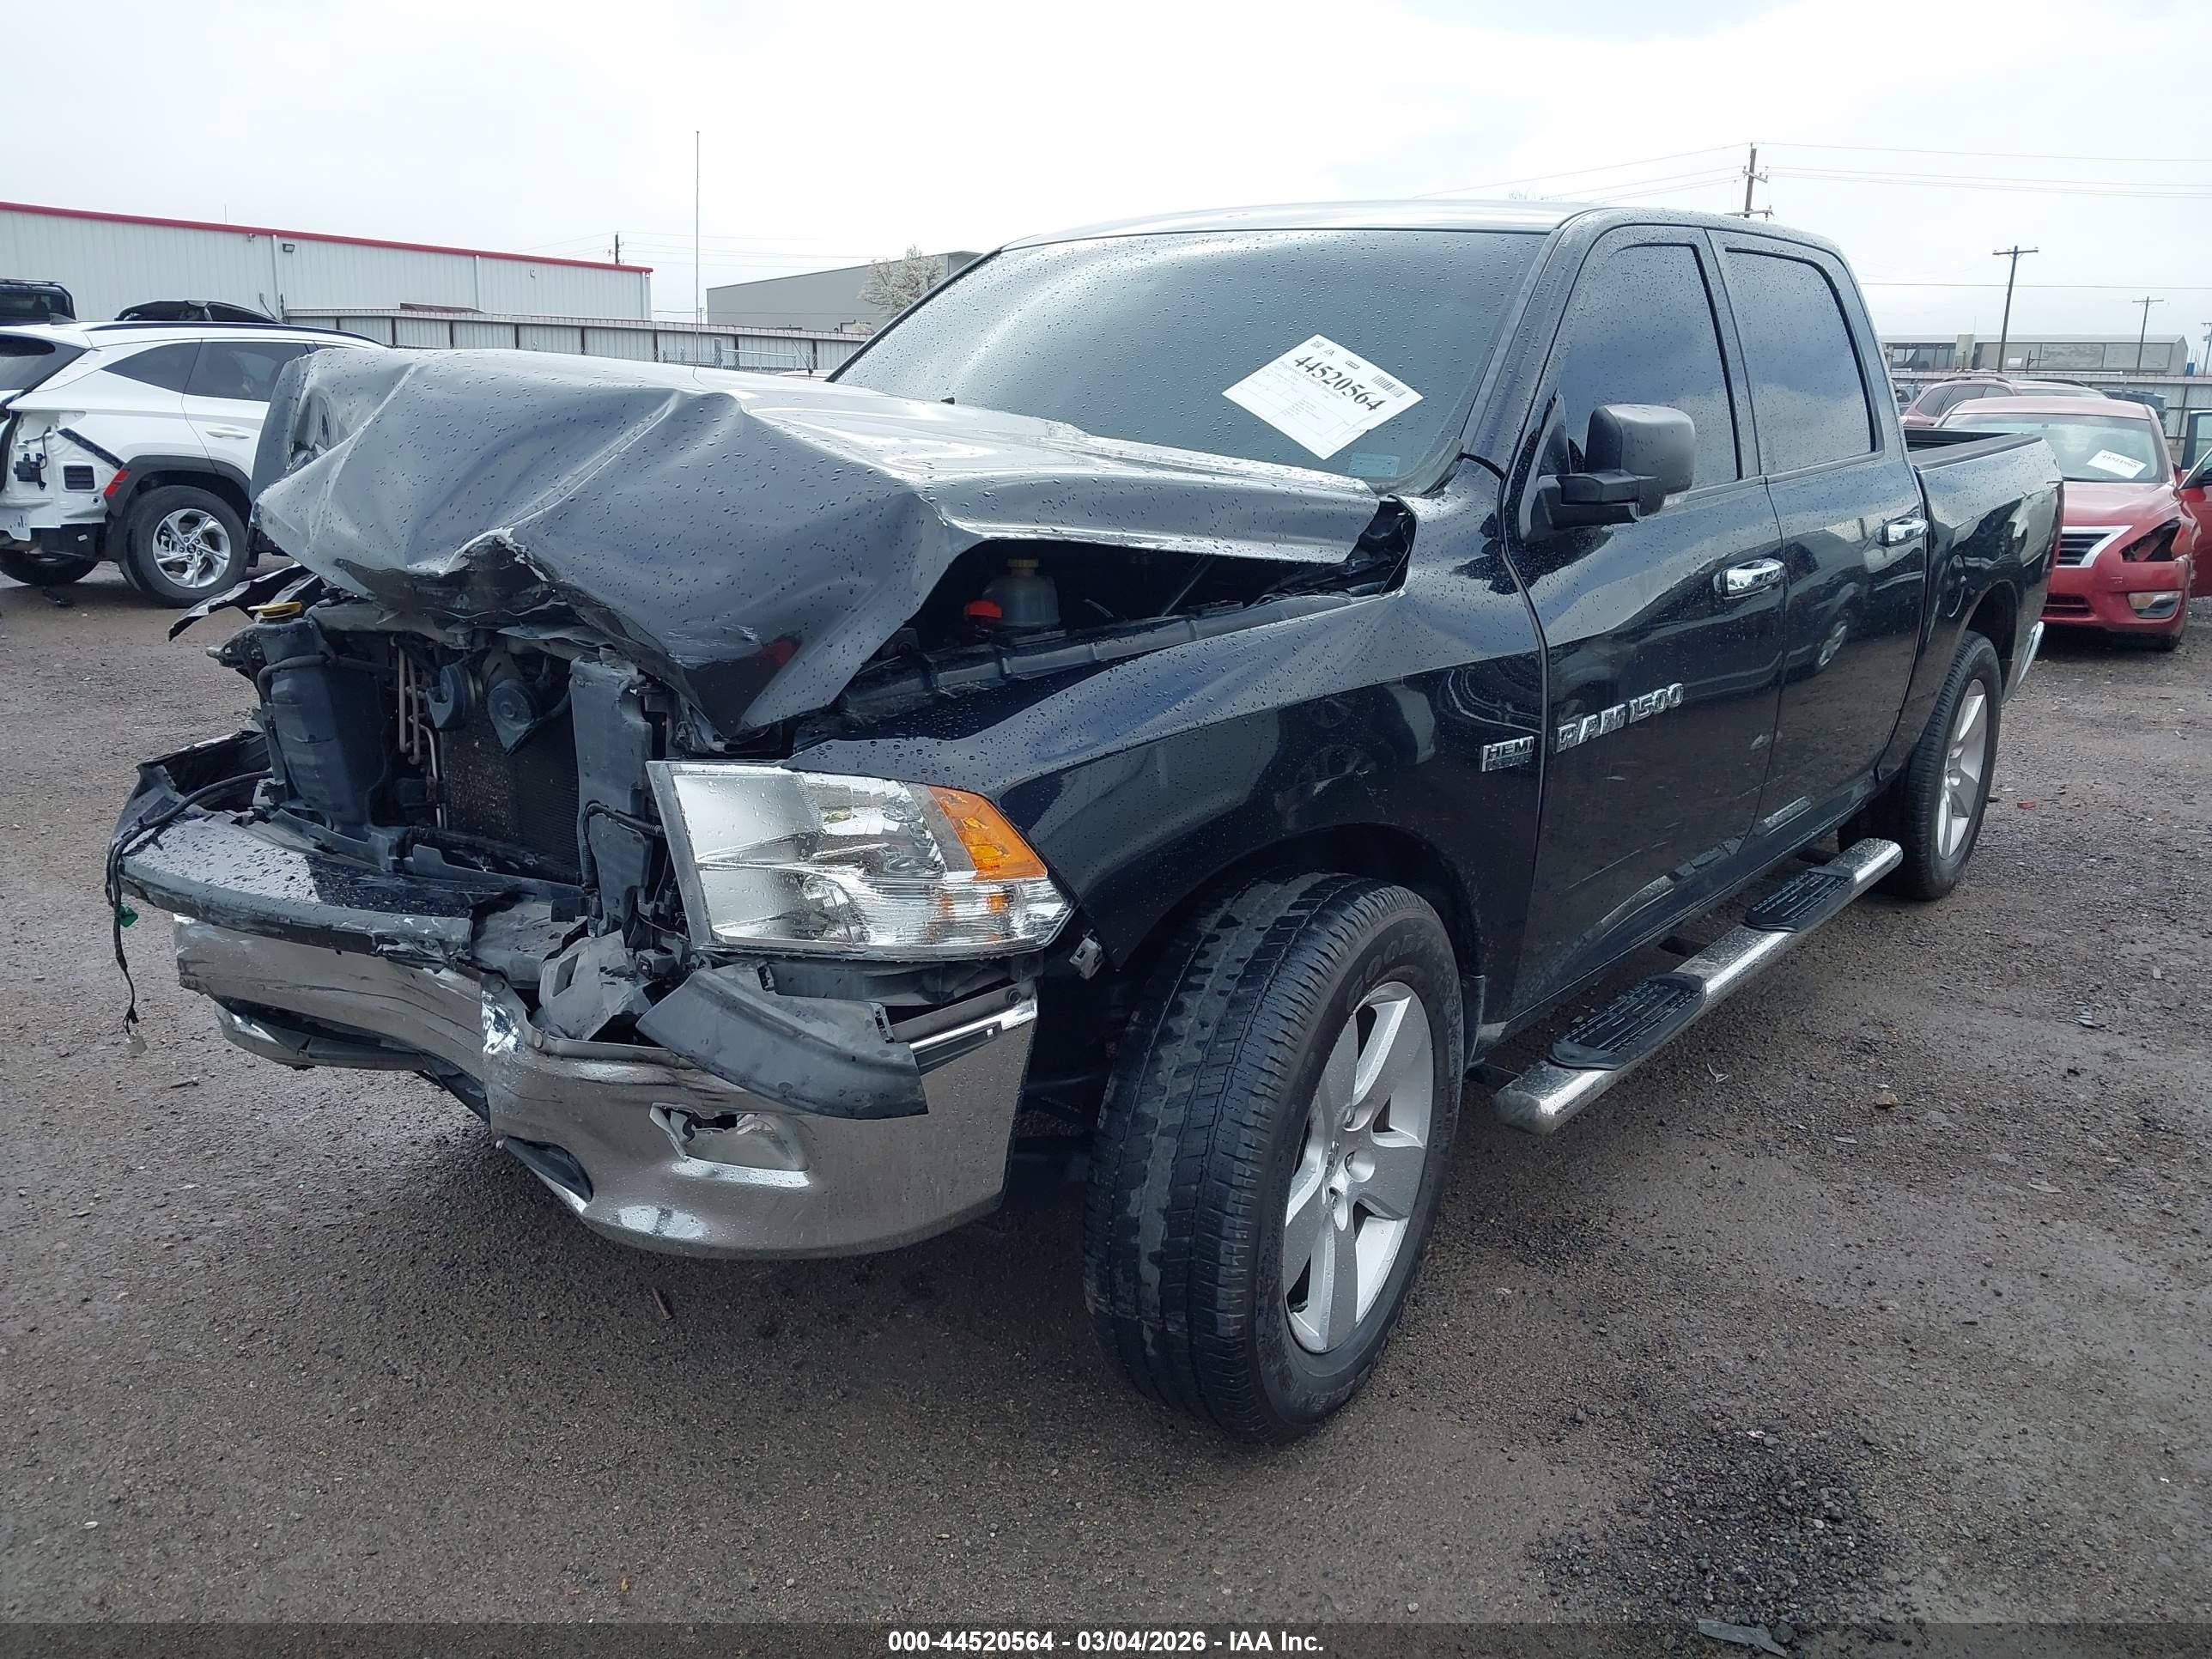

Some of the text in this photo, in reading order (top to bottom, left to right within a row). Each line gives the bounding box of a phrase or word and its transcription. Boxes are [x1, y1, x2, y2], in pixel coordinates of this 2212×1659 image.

[1294, 356, 1387, 410] 44520564
[1556, 682, 1685, 753] RAM 1500
[1483, 736, 1535, 763] HEMI
